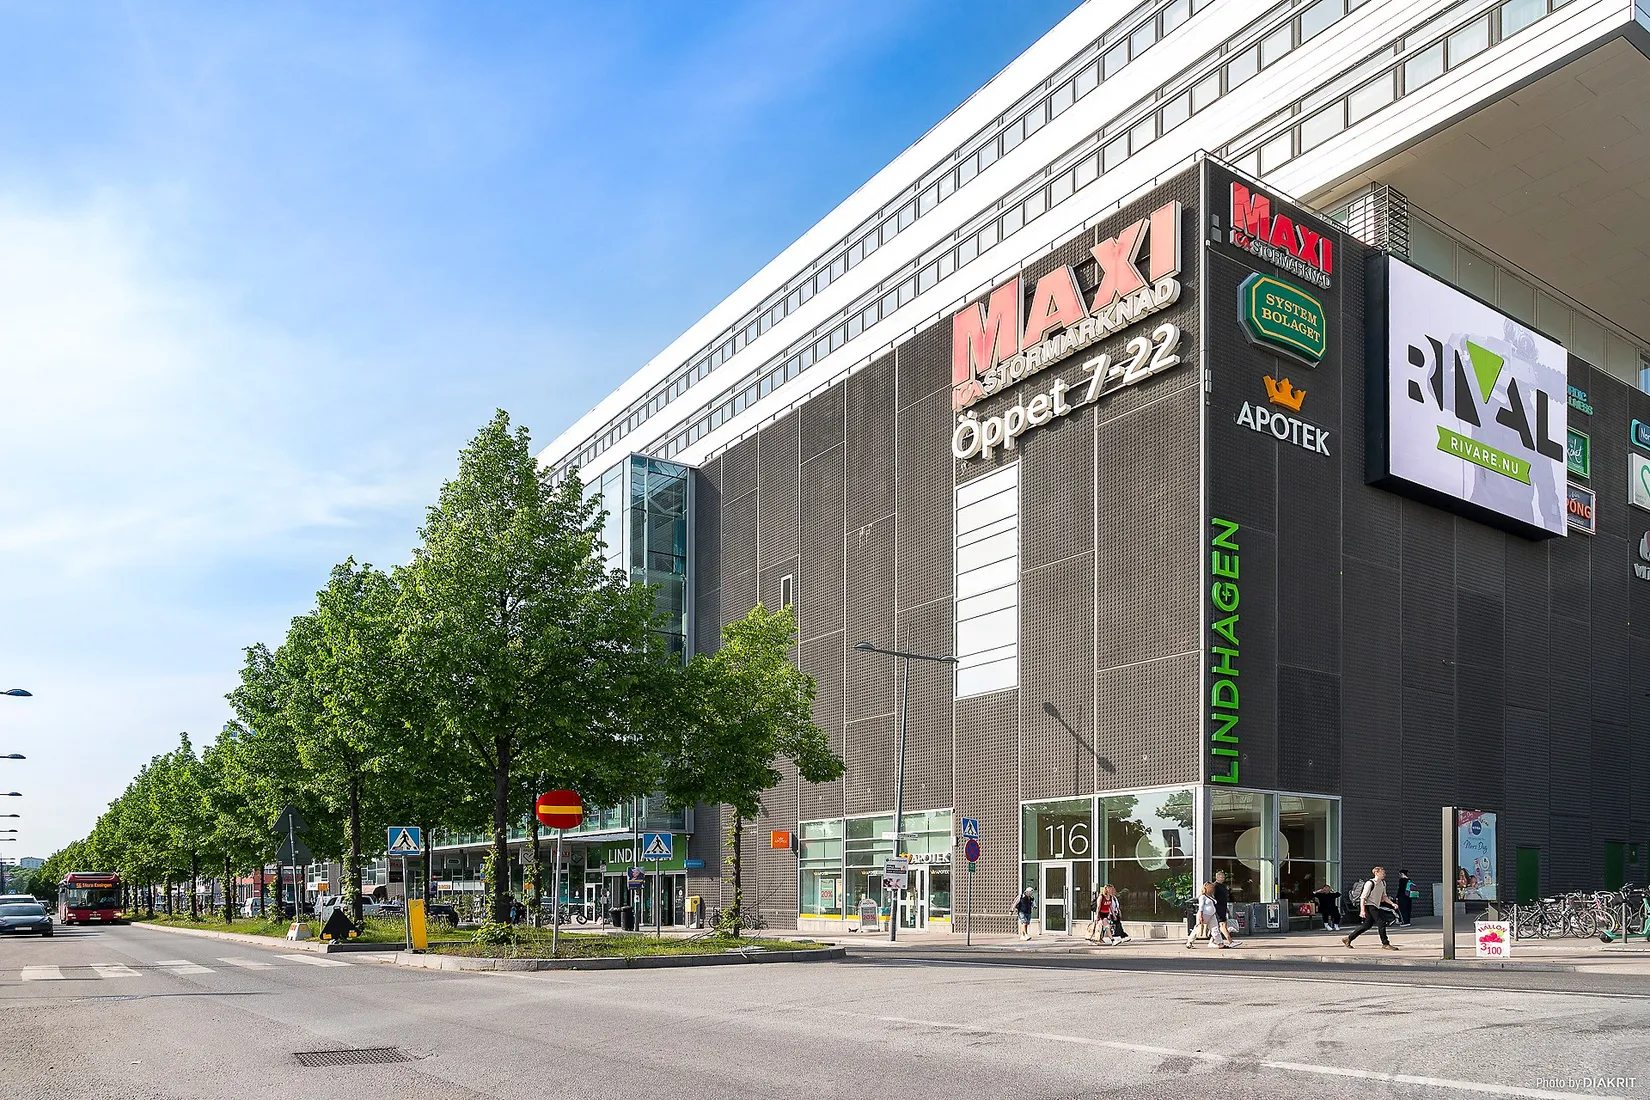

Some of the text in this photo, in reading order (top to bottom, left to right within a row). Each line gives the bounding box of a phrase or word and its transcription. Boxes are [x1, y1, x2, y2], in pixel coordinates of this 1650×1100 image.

[1230, 181, 1332, 275] MAXI
[1250, 240, 1331, 289] STORMARKNAD
[952, 199, 1183, 388] MAXI
[1265, 293, 1318, 327] SYSTEM
[953, 277, 1182, 412] ICA STORMARKNAD
[1261, 307, 1321, 343] BOLAGET
[951, 323, 1181, 460] Öppet 7-22
[1407, 335, 1565, 463] RIVAL
[1236, 401, 1331, 457] APOTEK
[1450, 436, 1520, 475] RIVARE.NU
[1567, 498, 1592, 519] ONG
[1211, 517, 1240, 783] LINDHAGEN
[911, 853, 951, 864] APOTEK
[1045, 823, 1089, 855] 116
[1478, 924, 1507, 933] HALLON
[1480, 942, 1502, 955] 3 100
